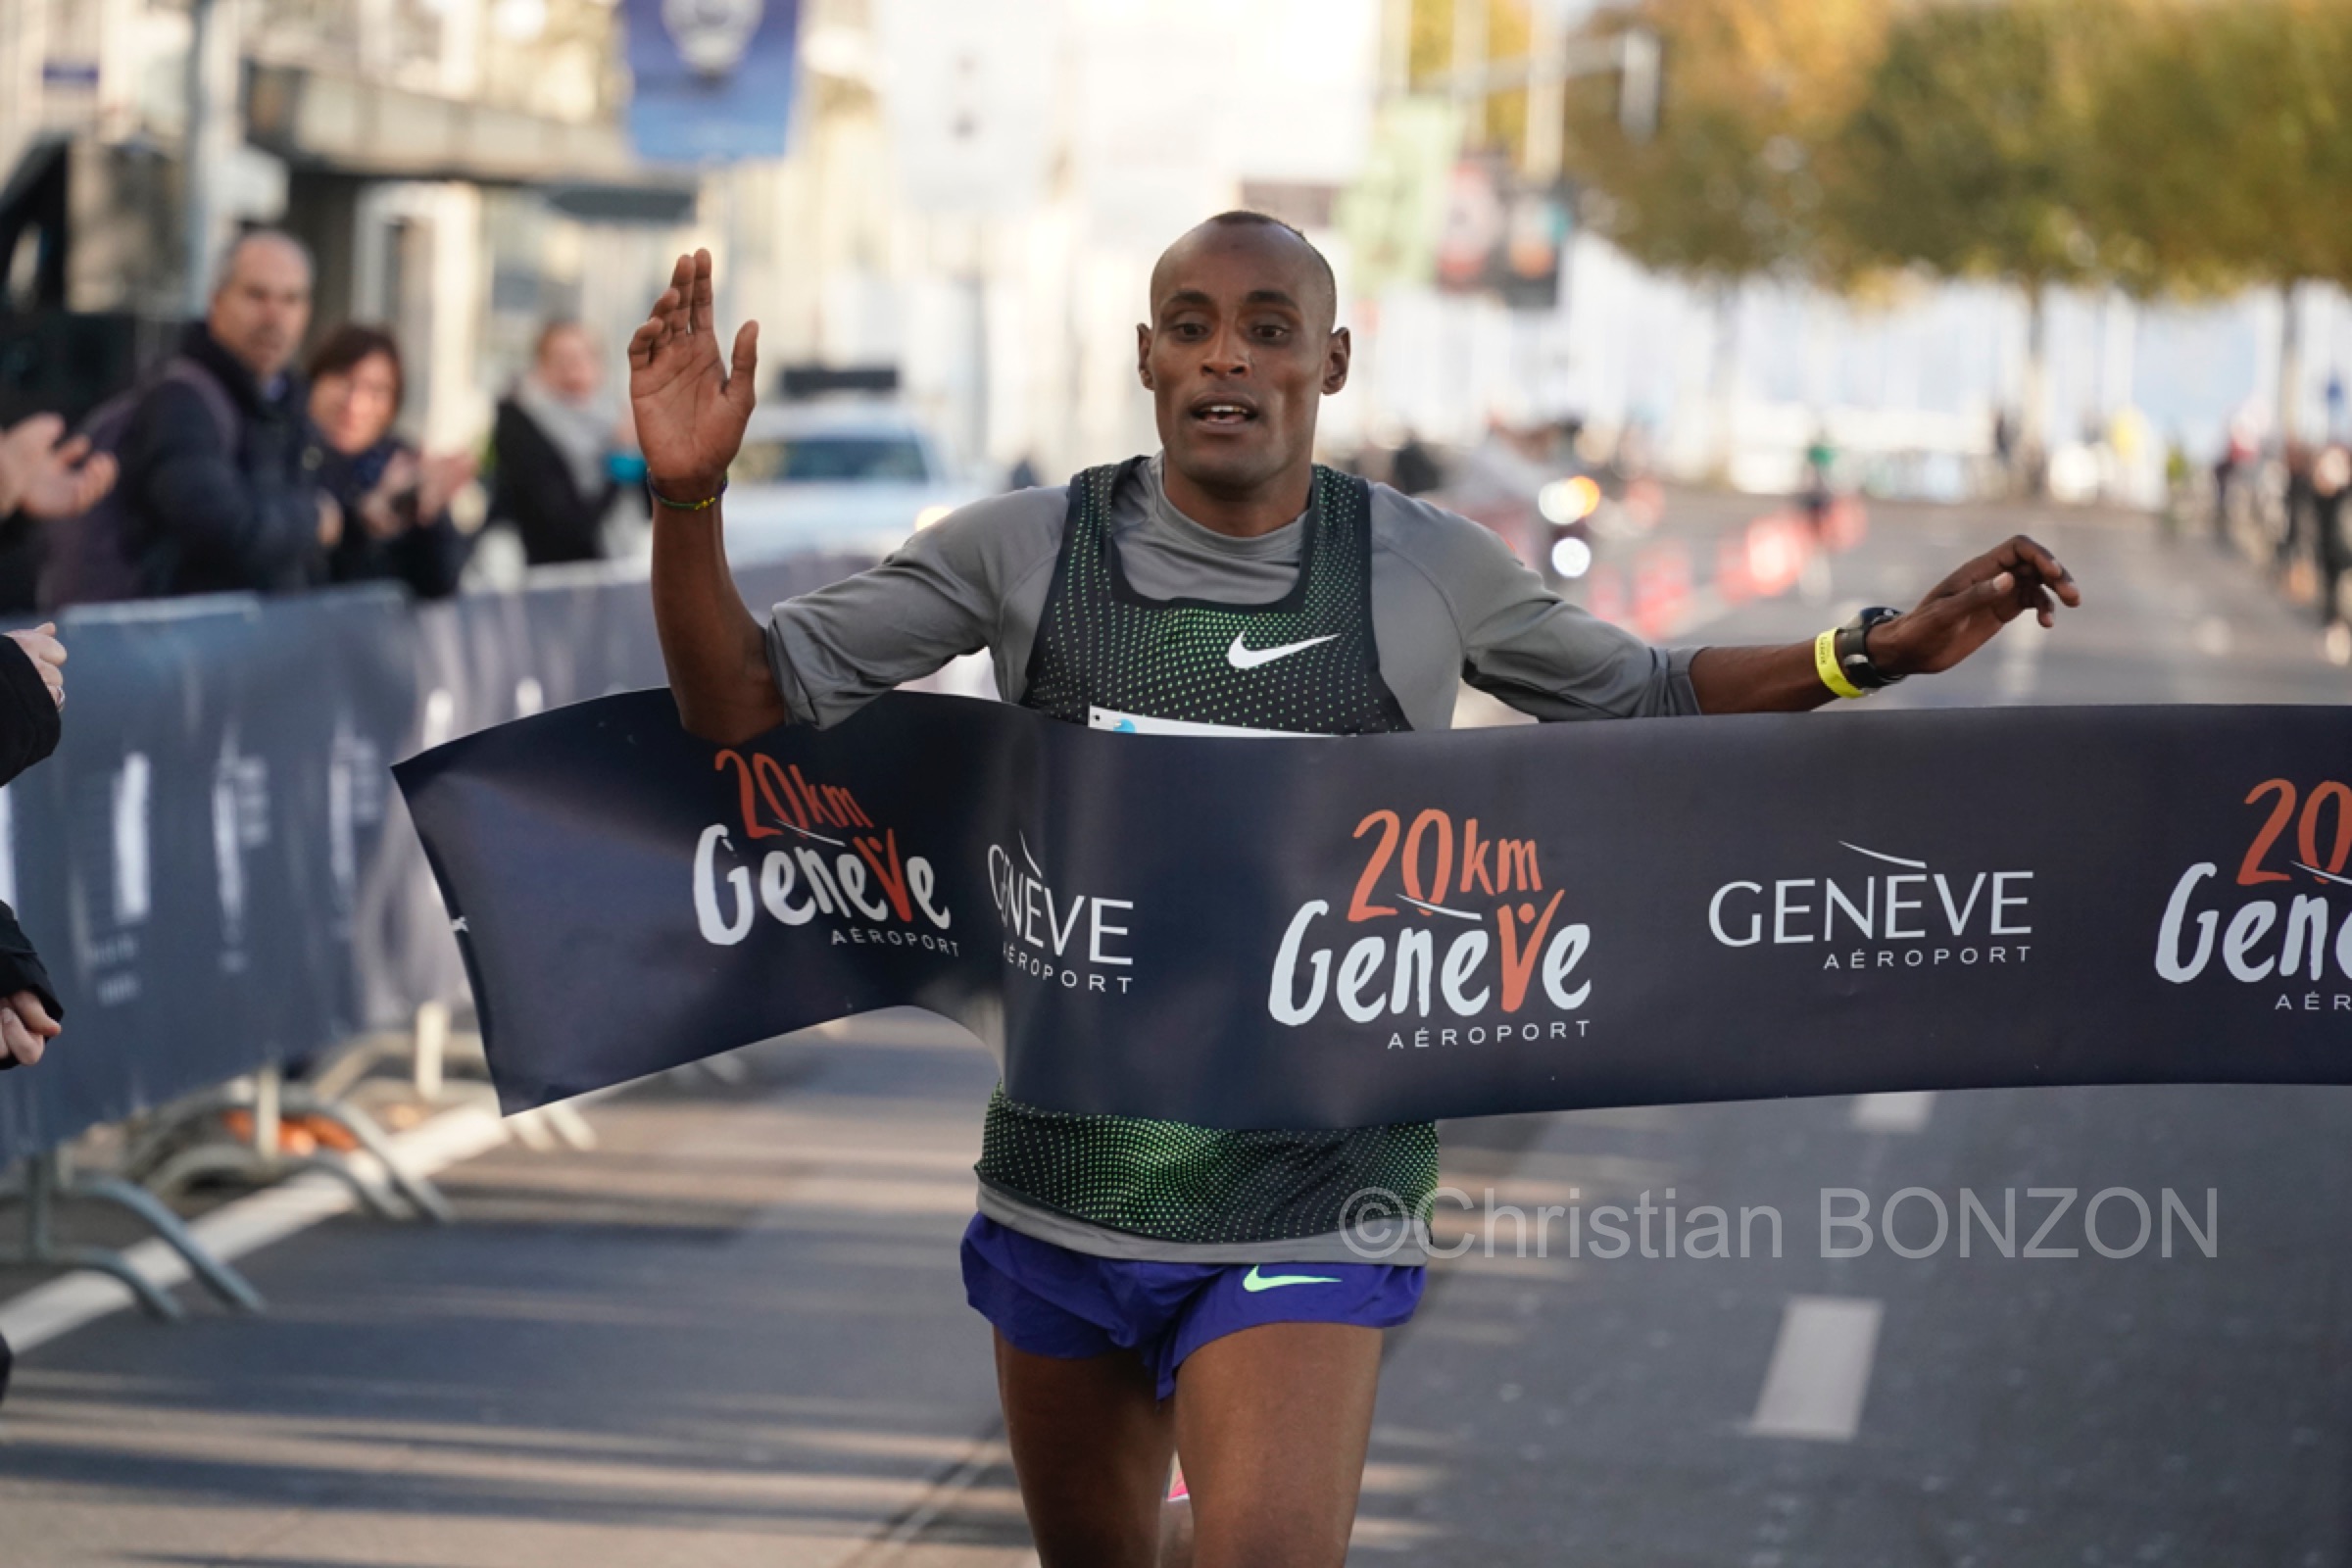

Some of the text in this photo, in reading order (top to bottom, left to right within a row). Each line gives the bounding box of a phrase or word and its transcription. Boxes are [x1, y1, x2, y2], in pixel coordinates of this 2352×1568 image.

[2235, 778, 2352, 886] 20
[1708, 841, 2034, 948] GENÈVE
[831, 927, 959, 956] AÉROPORT
[1823, 945, 2032, 970] AÉROPORT
[1388, 1019, 1592, 1050] AÉROPORT
